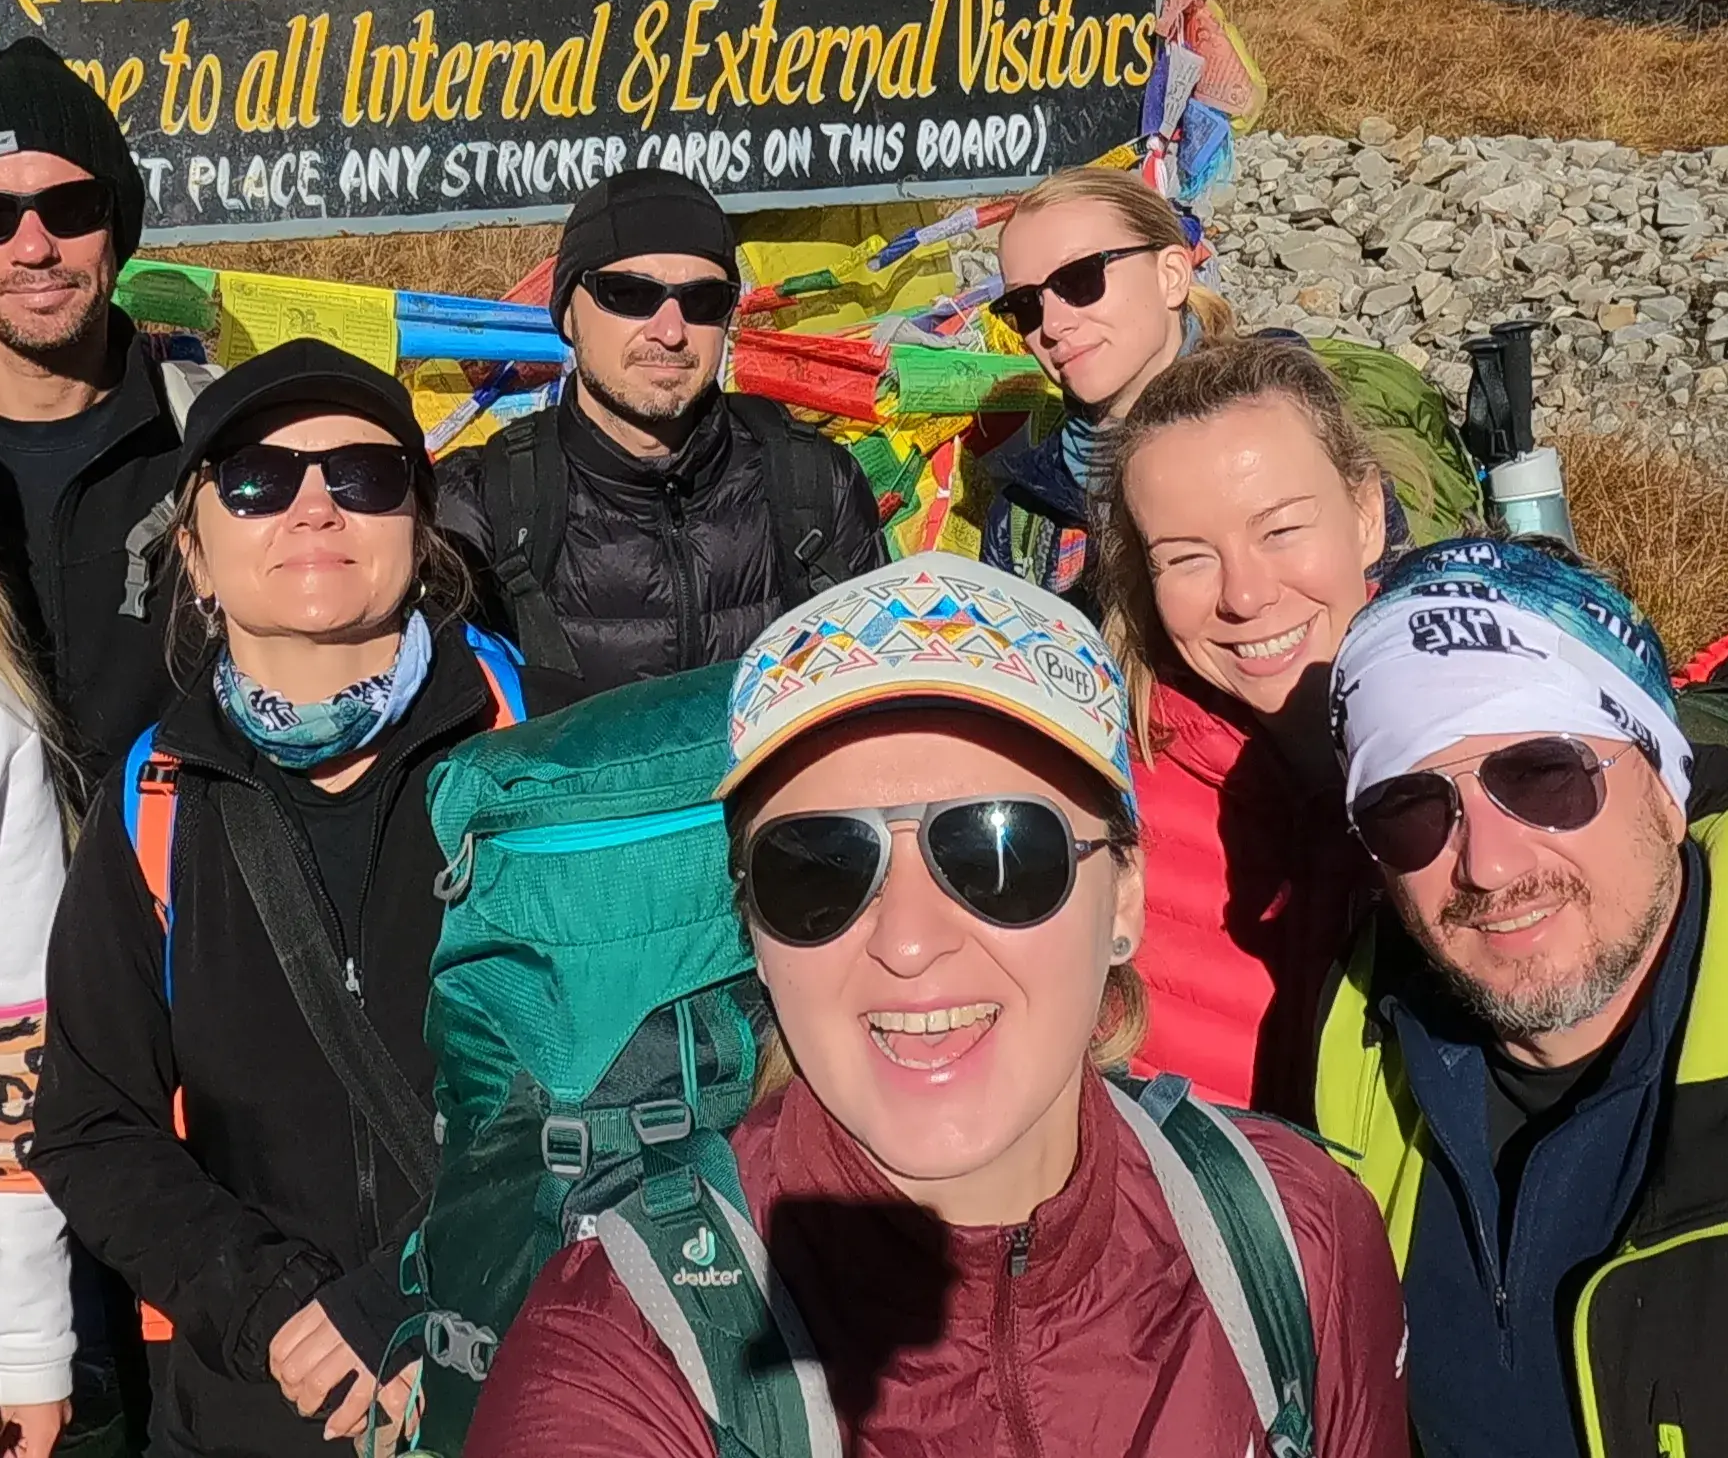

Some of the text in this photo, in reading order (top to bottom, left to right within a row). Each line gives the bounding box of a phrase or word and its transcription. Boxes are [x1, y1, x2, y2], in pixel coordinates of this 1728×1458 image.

[159, 18, 223, 136] to
[235, 12, 329, 133] all
[340, 1, 612, 128] Internal
[187, 150, 327, 218] PLACE
[339, 144, 431, 203] ANY
[440, 134, 627, 198] STRICKER
[764, 125, 812, 179] ON
[819, 120, 906, 178] THIS
[917, 103, 1048, 173] BOARD)
[672, 1265, 743, 1287] deuter
